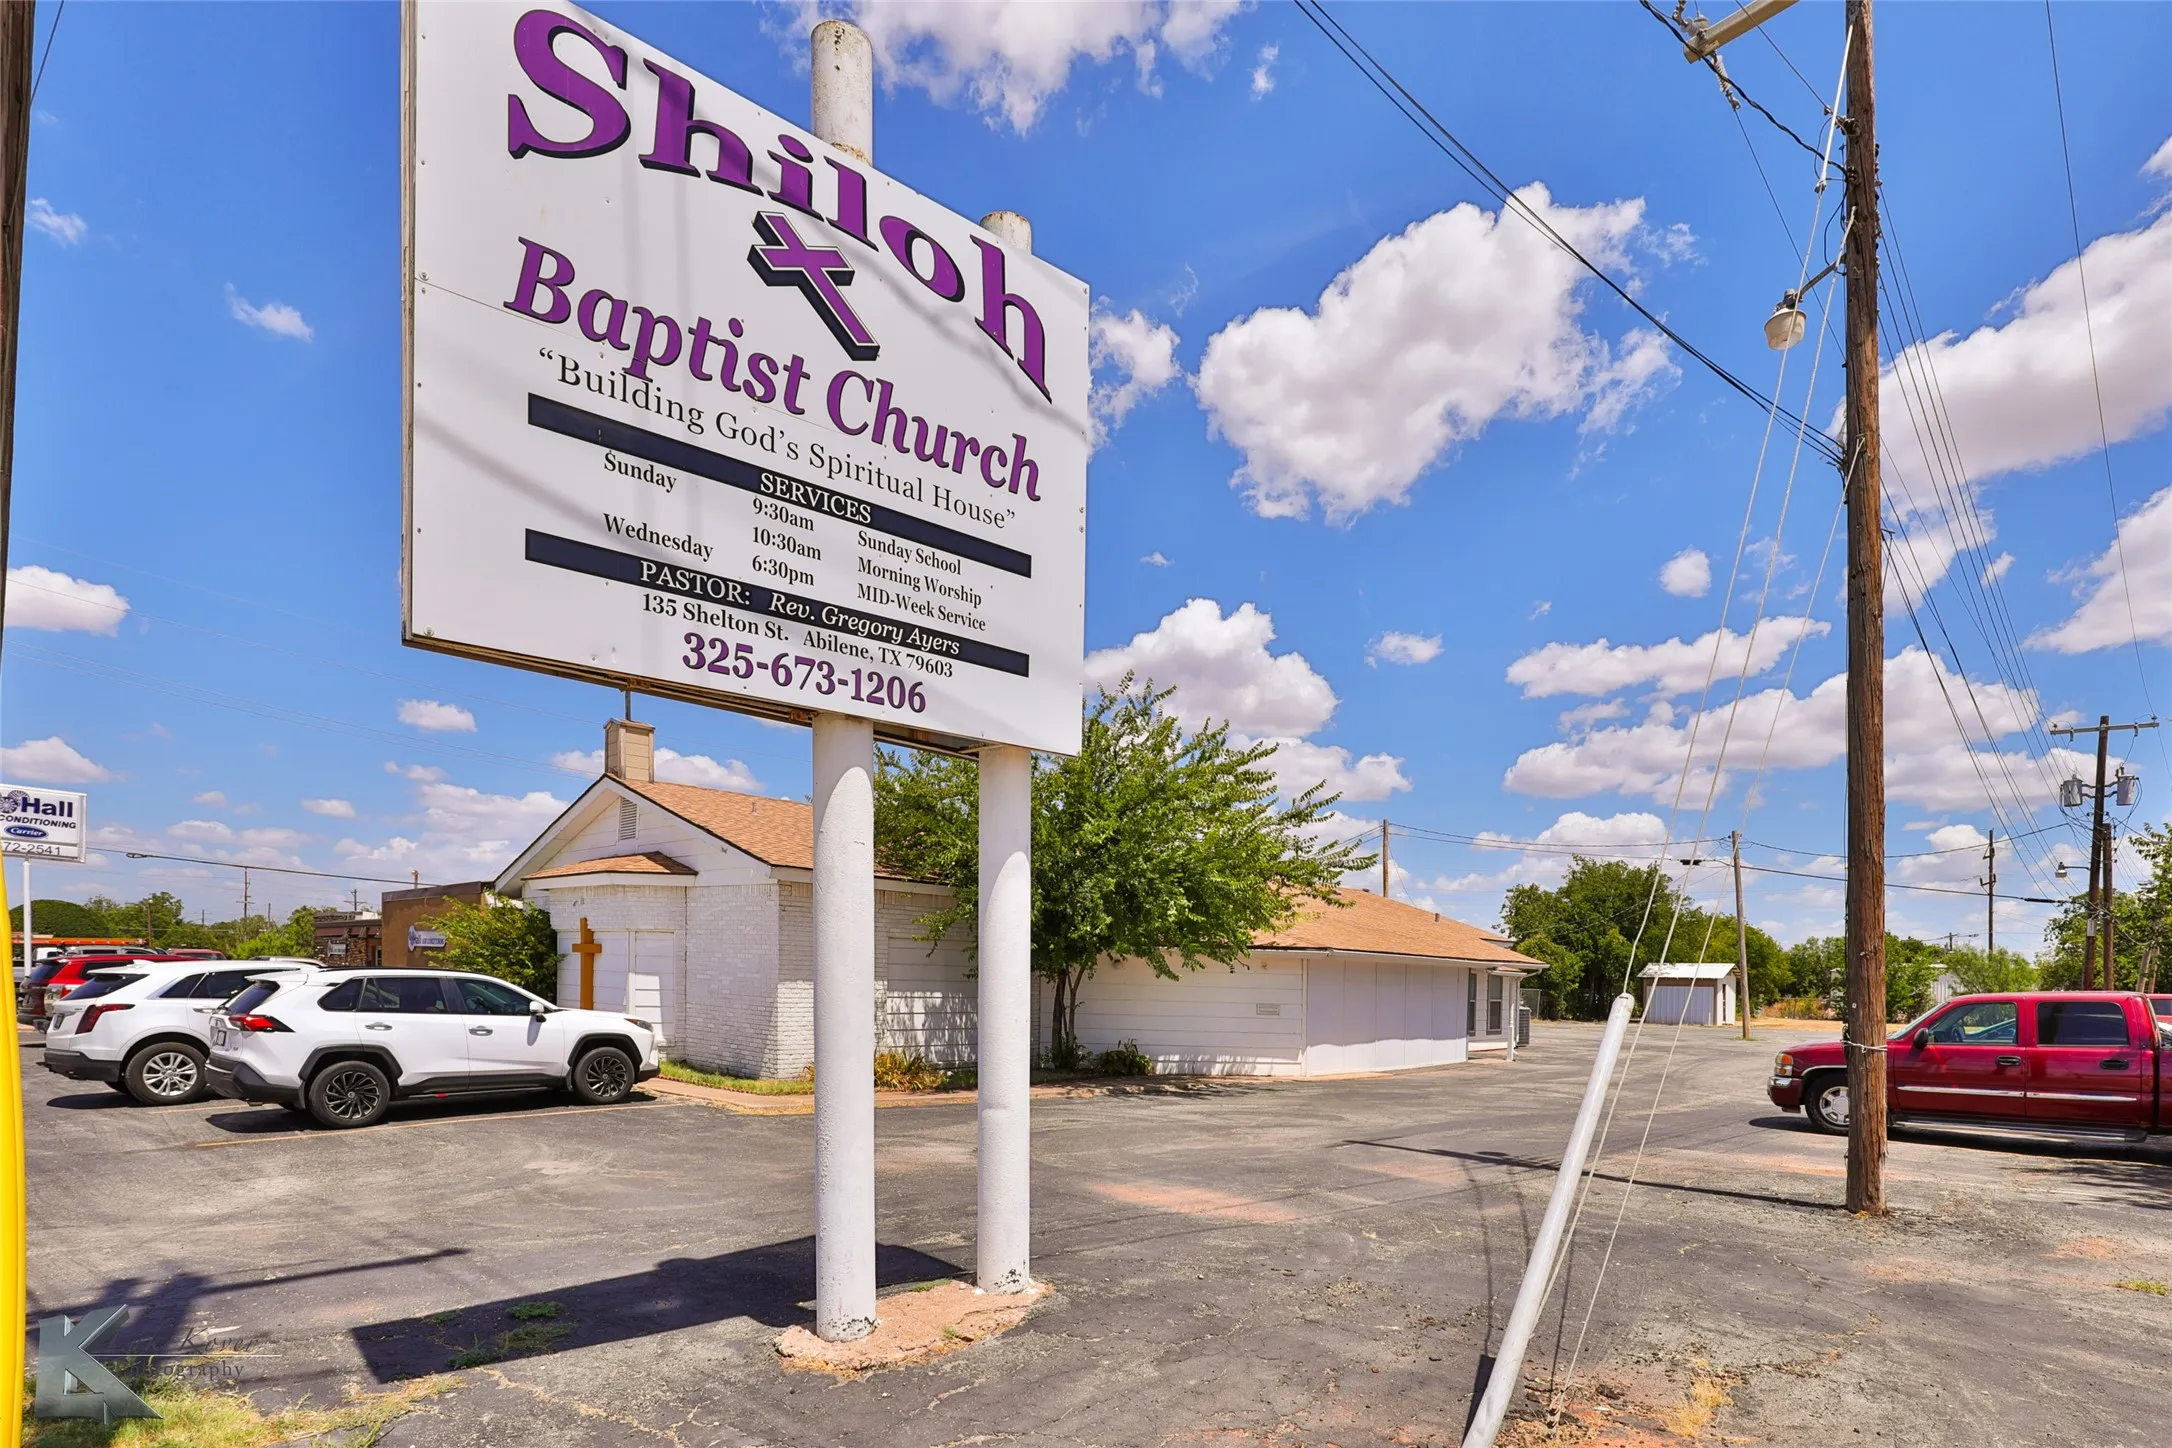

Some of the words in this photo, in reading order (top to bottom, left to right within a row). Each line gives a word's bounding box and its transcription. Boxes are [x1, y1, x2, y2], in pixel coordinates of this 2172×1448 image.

[508, 8, 1052, 405] Shiloh
[503, 236, 811, 416] Baptist
[826, 369, 1042, 502] Church
[539, 347, 705, 436] “Building
[715, 411, 800, 461] God’s
[809, 442, 923, 503] Spiritual
[932, 484, 1016, 529] House”
[603, 451, 677, 493] Sunday
[752, 497, 815, 532] 9:30am
[759, 472, 872, 525] SERVICES
[603, 513, 714, 562] Wednesday
[752, 526, 822, 561] 10:30am
[857, 529, 912, 563] Sunday
[915, 548, 962, 576] School
[752, 555, 815, 586] 6:30pm
[857, 556, 921, 593] Morning
[924, 575, 982, 610] Worship
[640, 560, 751, 606] PASTOR:
[768, 592, 816, 621] Rev.
[821, 605, 904, 645] Gregory
[906, 627, 961, 655] Ayers
[857, 583, 935, 618] MID-Week
[937, 604, 987, 632] Service
[642, 593, 677, 617] 135
[683, 602, 759, 636] Shelton
[764, 620, 790, 641] St.
[803, 630, 875, 663] Abilene,
[878, 646, 903, 667] TX
[905, 652, 954, 678] 79603
[682, 632, 927, 714] 325-673-1206
[21, 796, 73, 817] Hall
[10, 827, 43, 836] Carrier
